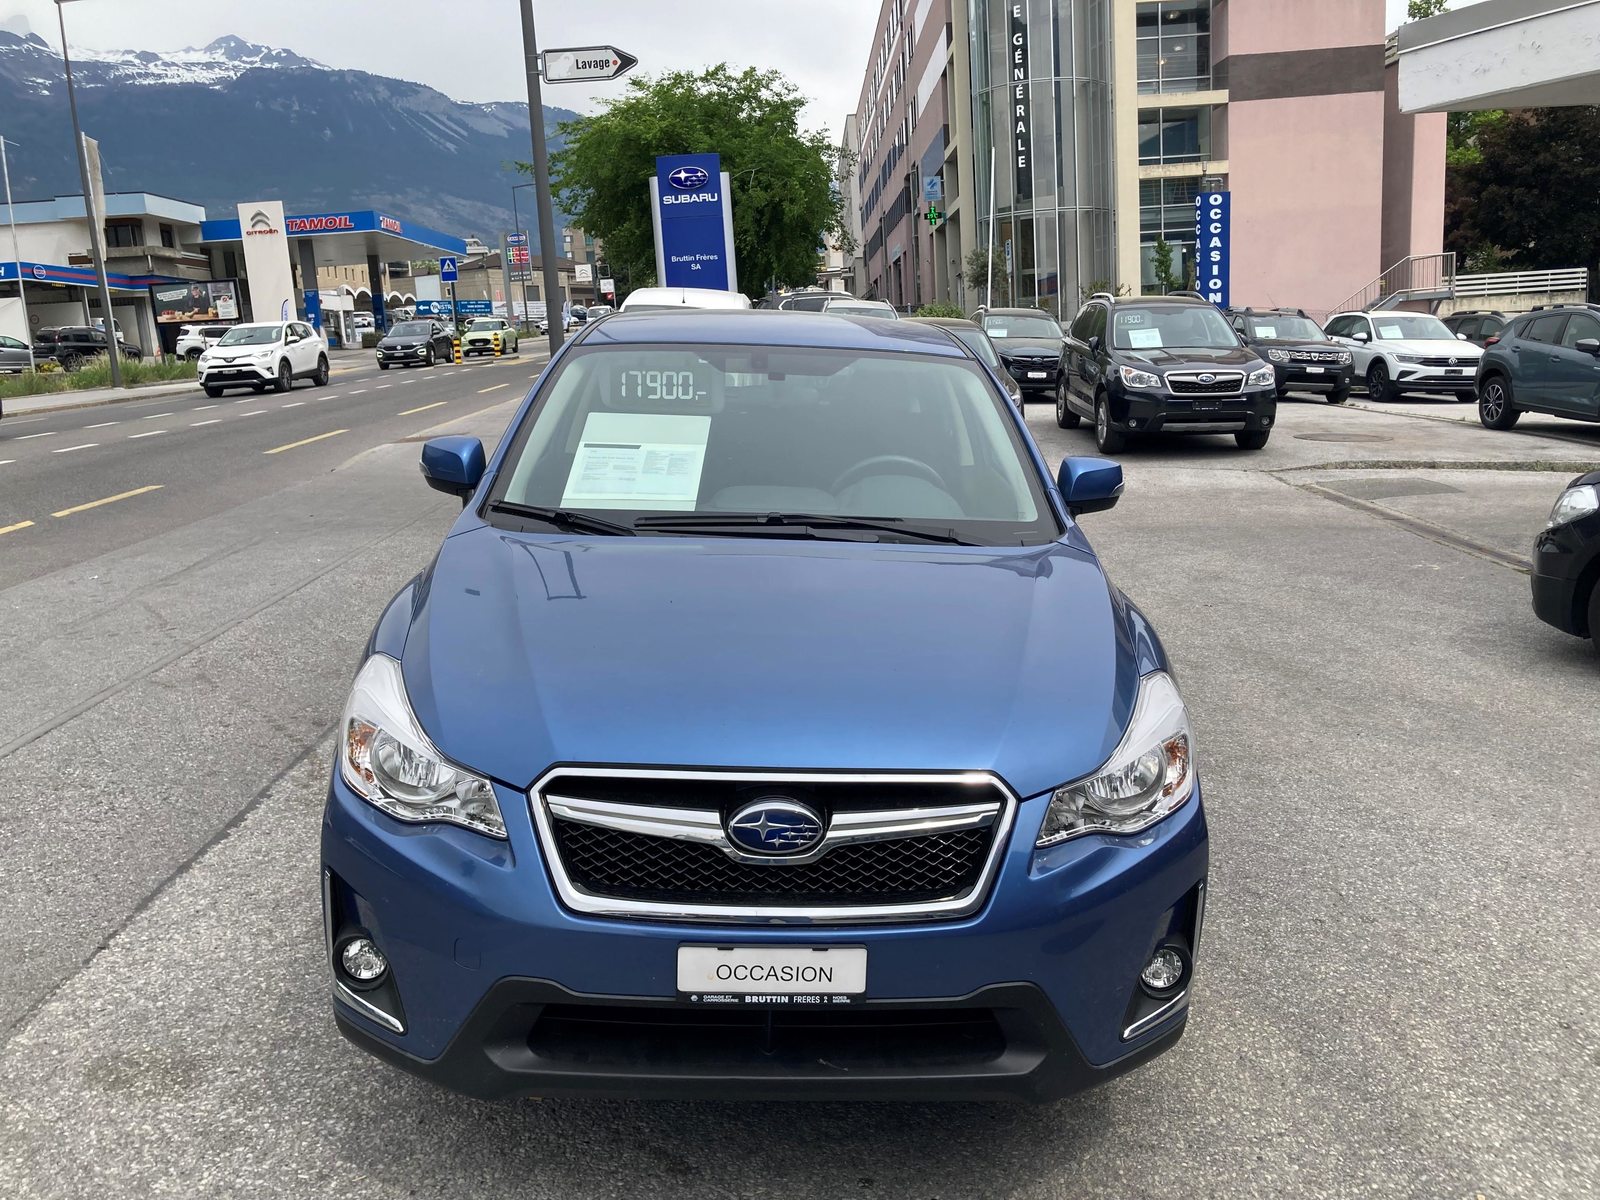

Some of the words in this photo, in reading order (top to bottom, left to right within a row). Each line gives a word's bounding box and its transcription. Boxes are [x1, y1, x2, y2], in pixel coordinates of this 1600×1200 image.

[576, 58, 610, 70] Lavage
[1012, 33, 1026, 168] GÉNÉRALE
[663, 193, 718, 205] SUBARU
[287, 215, 354, 231] TAMOIL
[1209, 194, 1223, 303] OCCASION
[671, 255, 695, 263] Bruttin
[716, 964, 833, 983] OCCASION
[745, 995, 789, 1003] BRUTTIN
